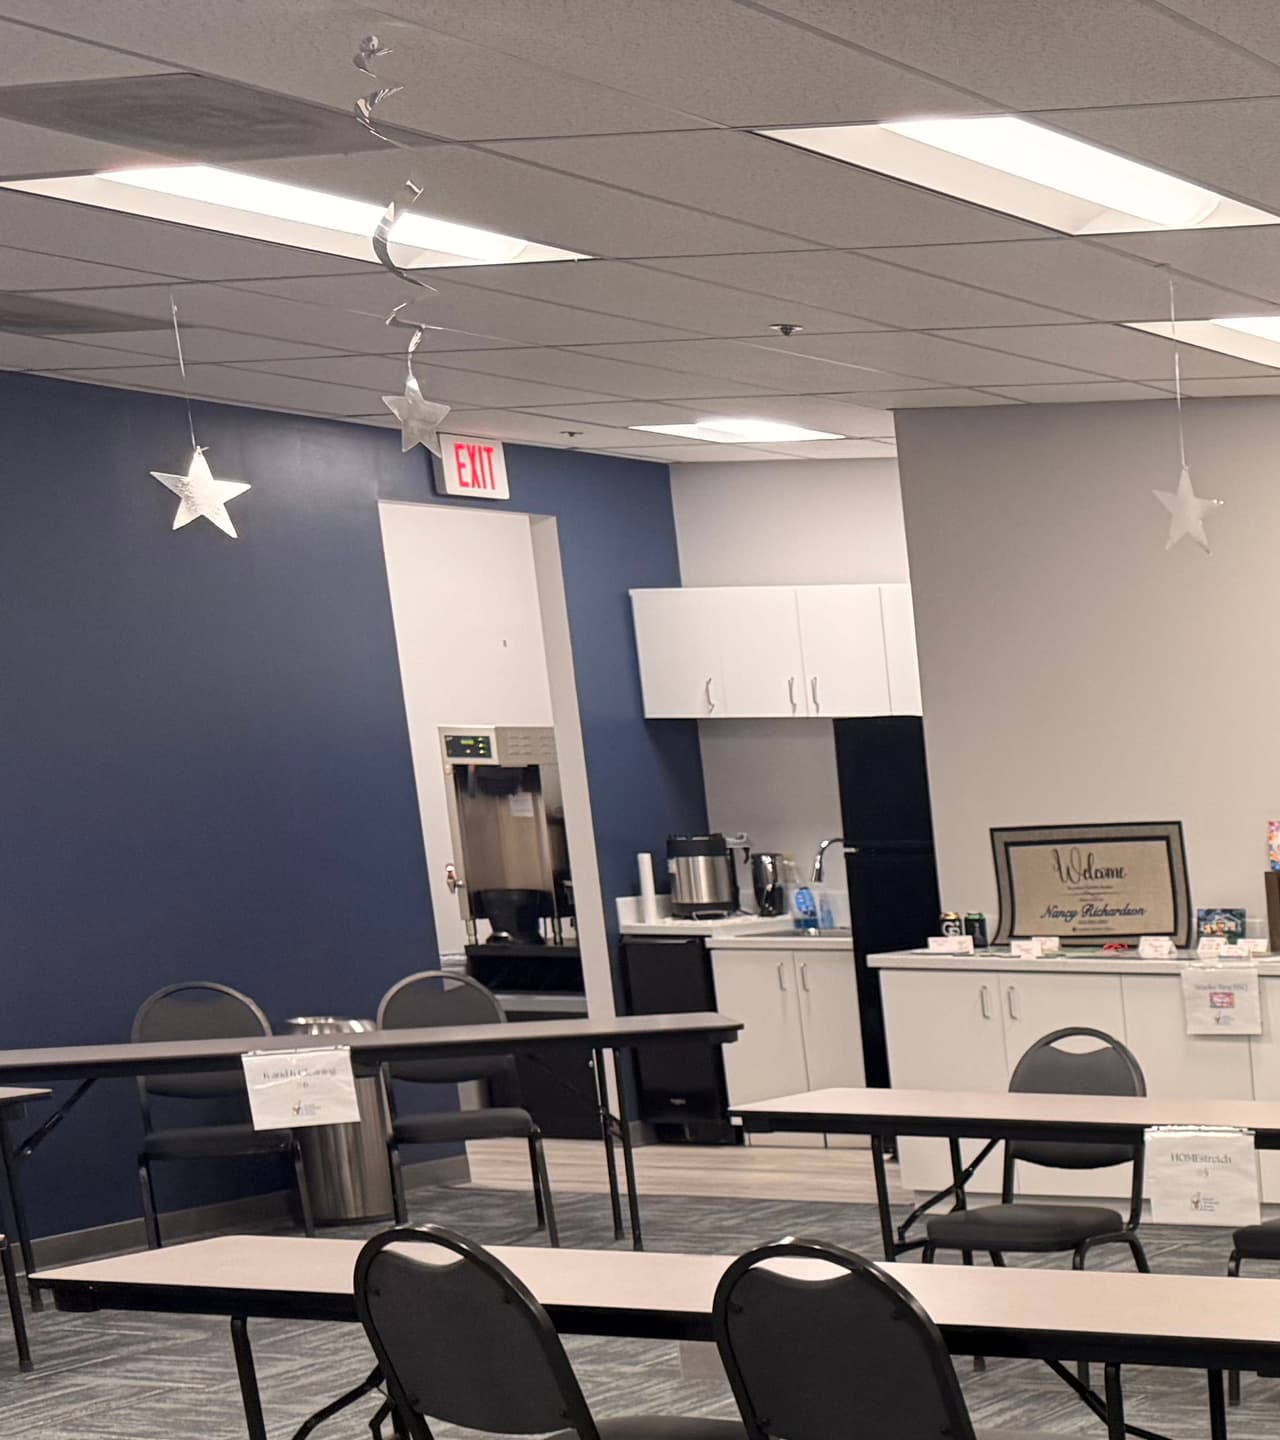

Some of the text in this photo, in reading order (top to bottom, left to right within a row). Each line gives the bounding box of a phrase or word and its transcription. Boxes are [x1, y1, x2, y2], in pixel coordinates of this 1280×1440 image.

[453, 442, 496, 490] EXIT
[1052, 847, 1127, 884] Welcome
[1040, 903, 1147, 923] Nancy Richardson
